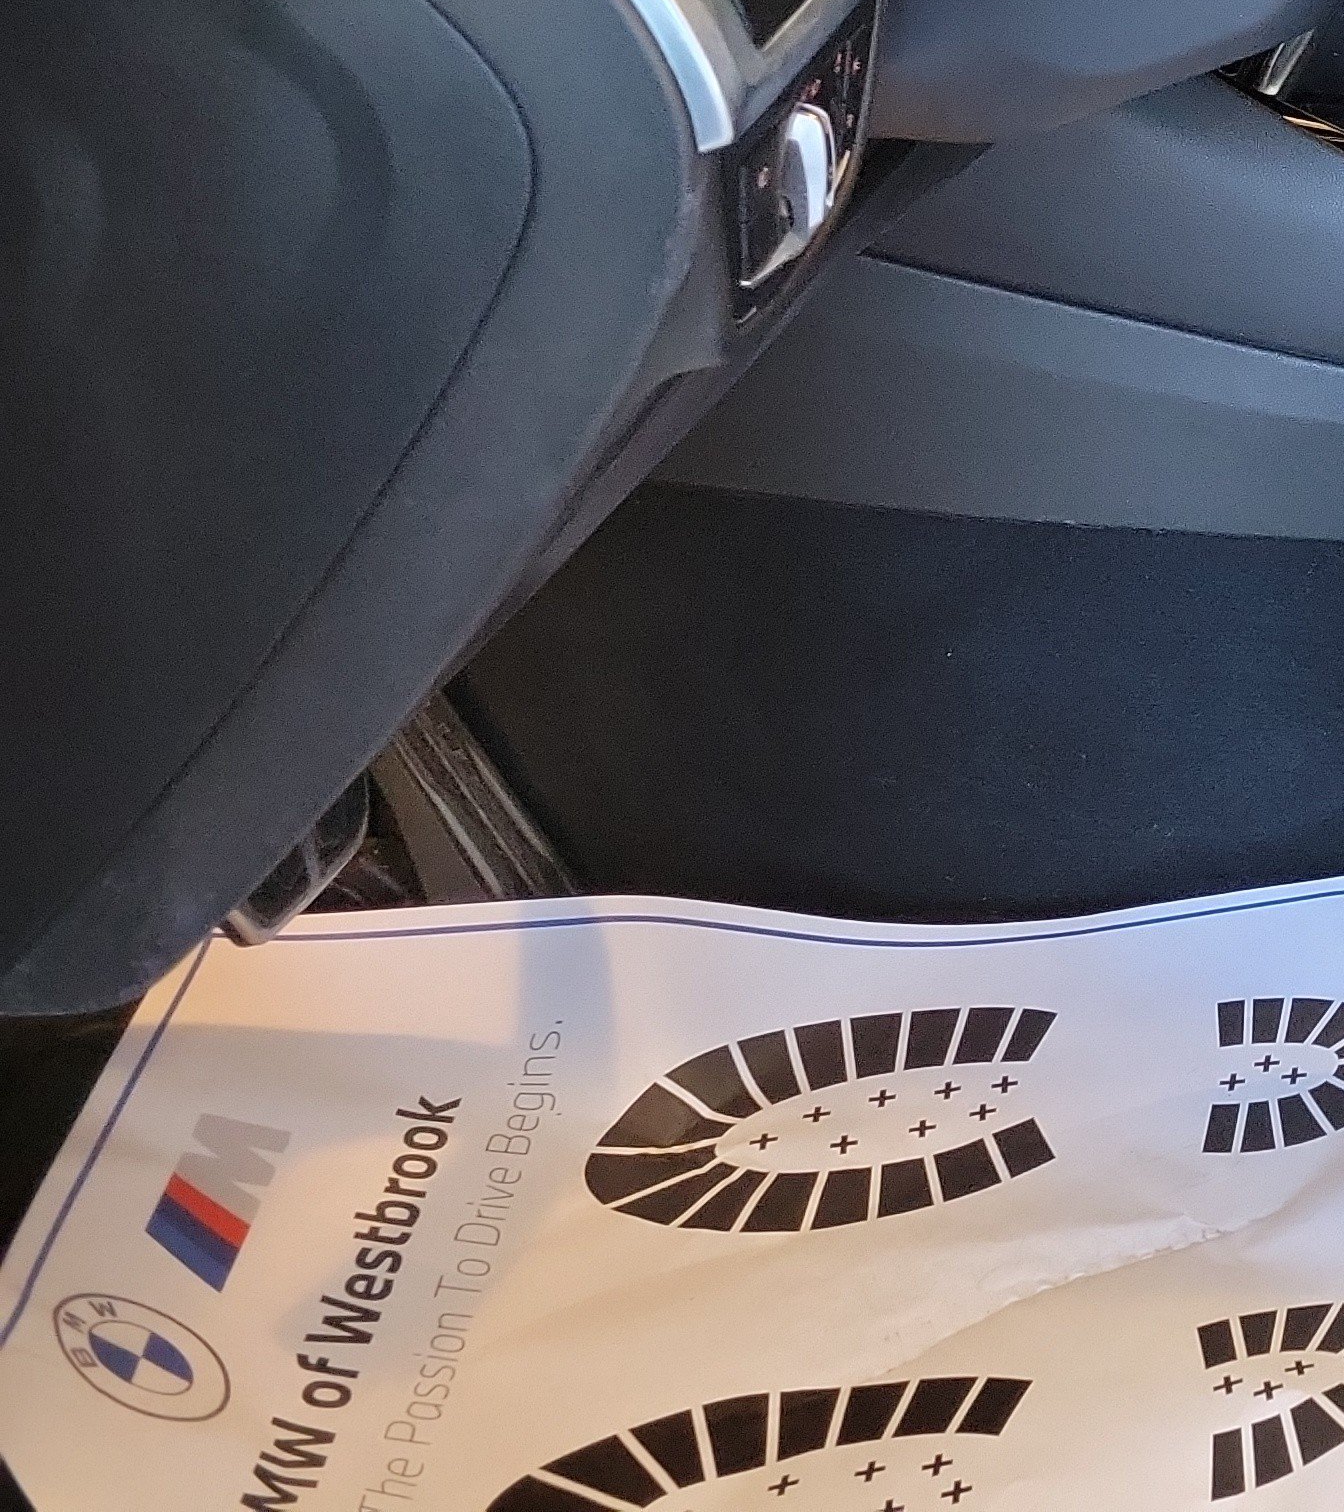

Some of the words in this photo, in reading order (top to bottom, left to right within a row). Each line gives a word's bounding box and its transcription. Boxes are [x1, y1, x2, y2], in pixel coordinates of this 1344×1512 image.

[485, 1019, 564, 1156] Begins.
[304, 1095, 462, 1345] Westbrook
[454, 1166, 522, 1246] Drive
[434, 1257, 491, 1299] To
[62, 1300, 118, 1368] BMW
[384, 1311, 474, 1445] Passion
[296, 1352, 360, 1409] of
[240, 1416, 337, 1512] MW
